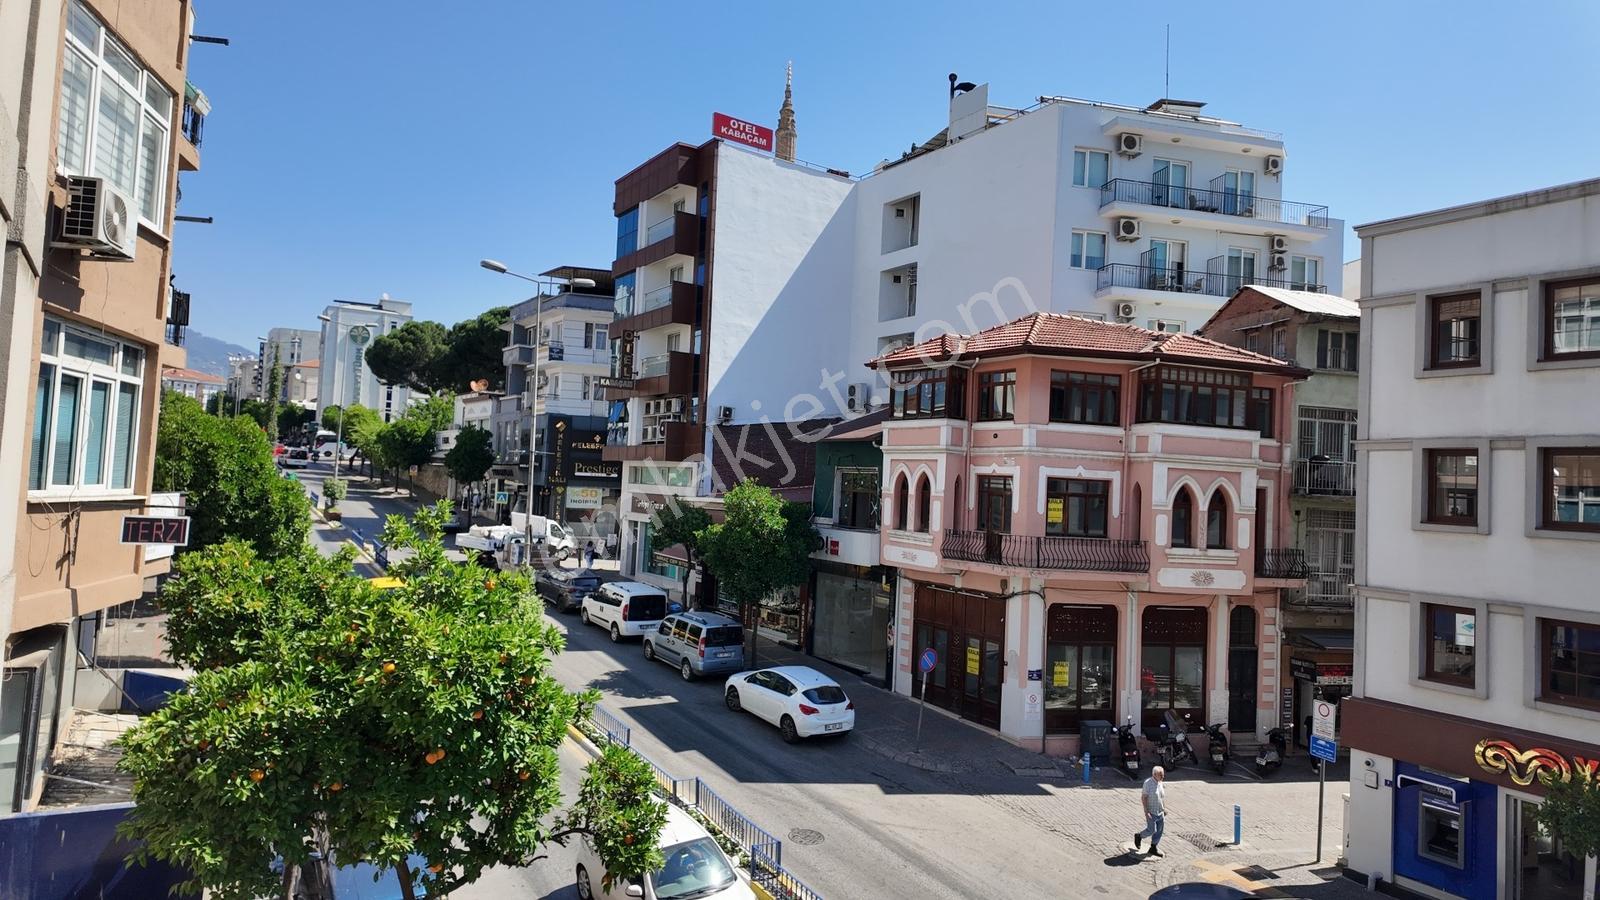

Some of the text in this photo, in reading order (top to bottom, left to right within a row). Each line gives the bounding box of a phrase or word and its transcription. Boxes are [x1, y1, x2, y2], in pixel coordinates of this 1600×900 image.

[721, 126, 767, 146] KABAÇAM
[729, 119, 759, 136] OTEL
[624, 330, 634, 377] OTEL
[574, 462, 619, 476] Prestige
